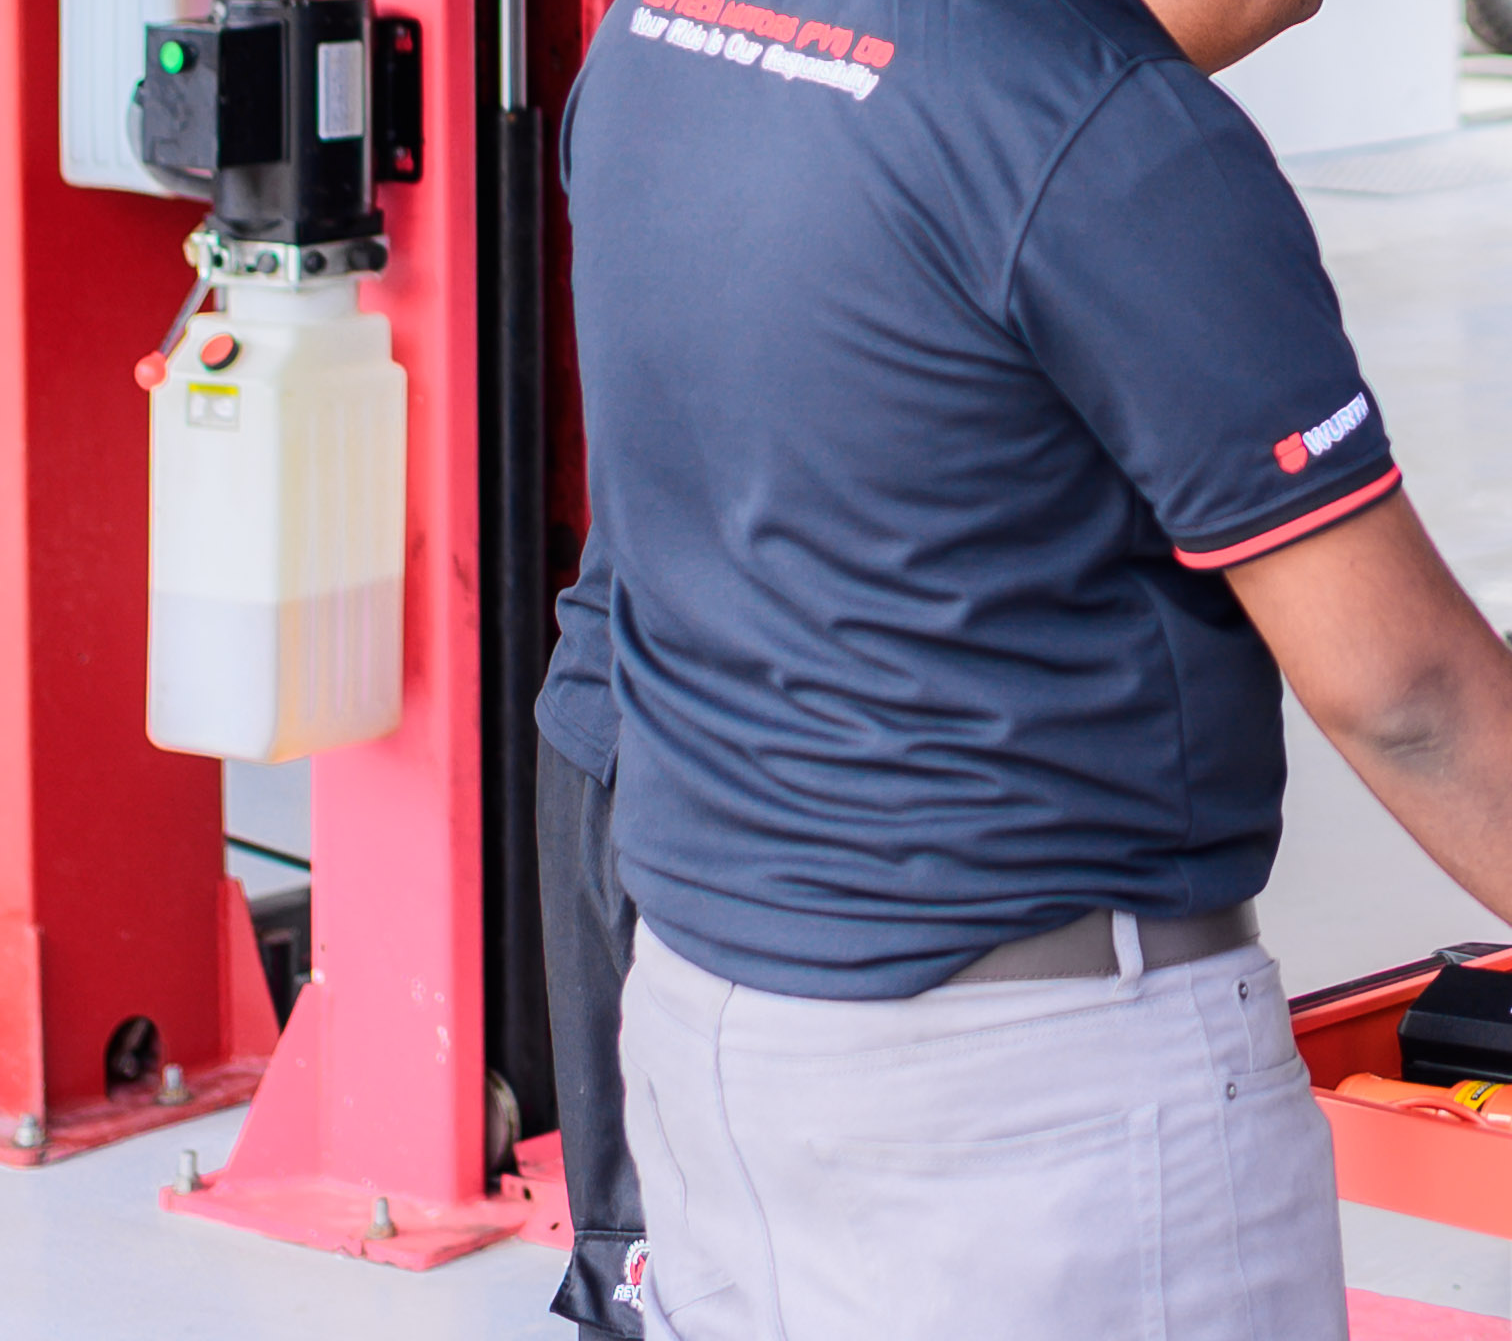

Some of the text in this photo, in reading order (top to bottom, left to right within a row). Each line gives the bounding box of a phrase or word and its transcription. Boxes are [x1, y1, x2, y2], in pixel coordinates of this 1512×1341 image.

[630, 6, 670, 38] Your
[665, 17, 709, 52] Ride
[723, 33, 764, 66] Our
[761, 43, 880, 101] Responsibility
